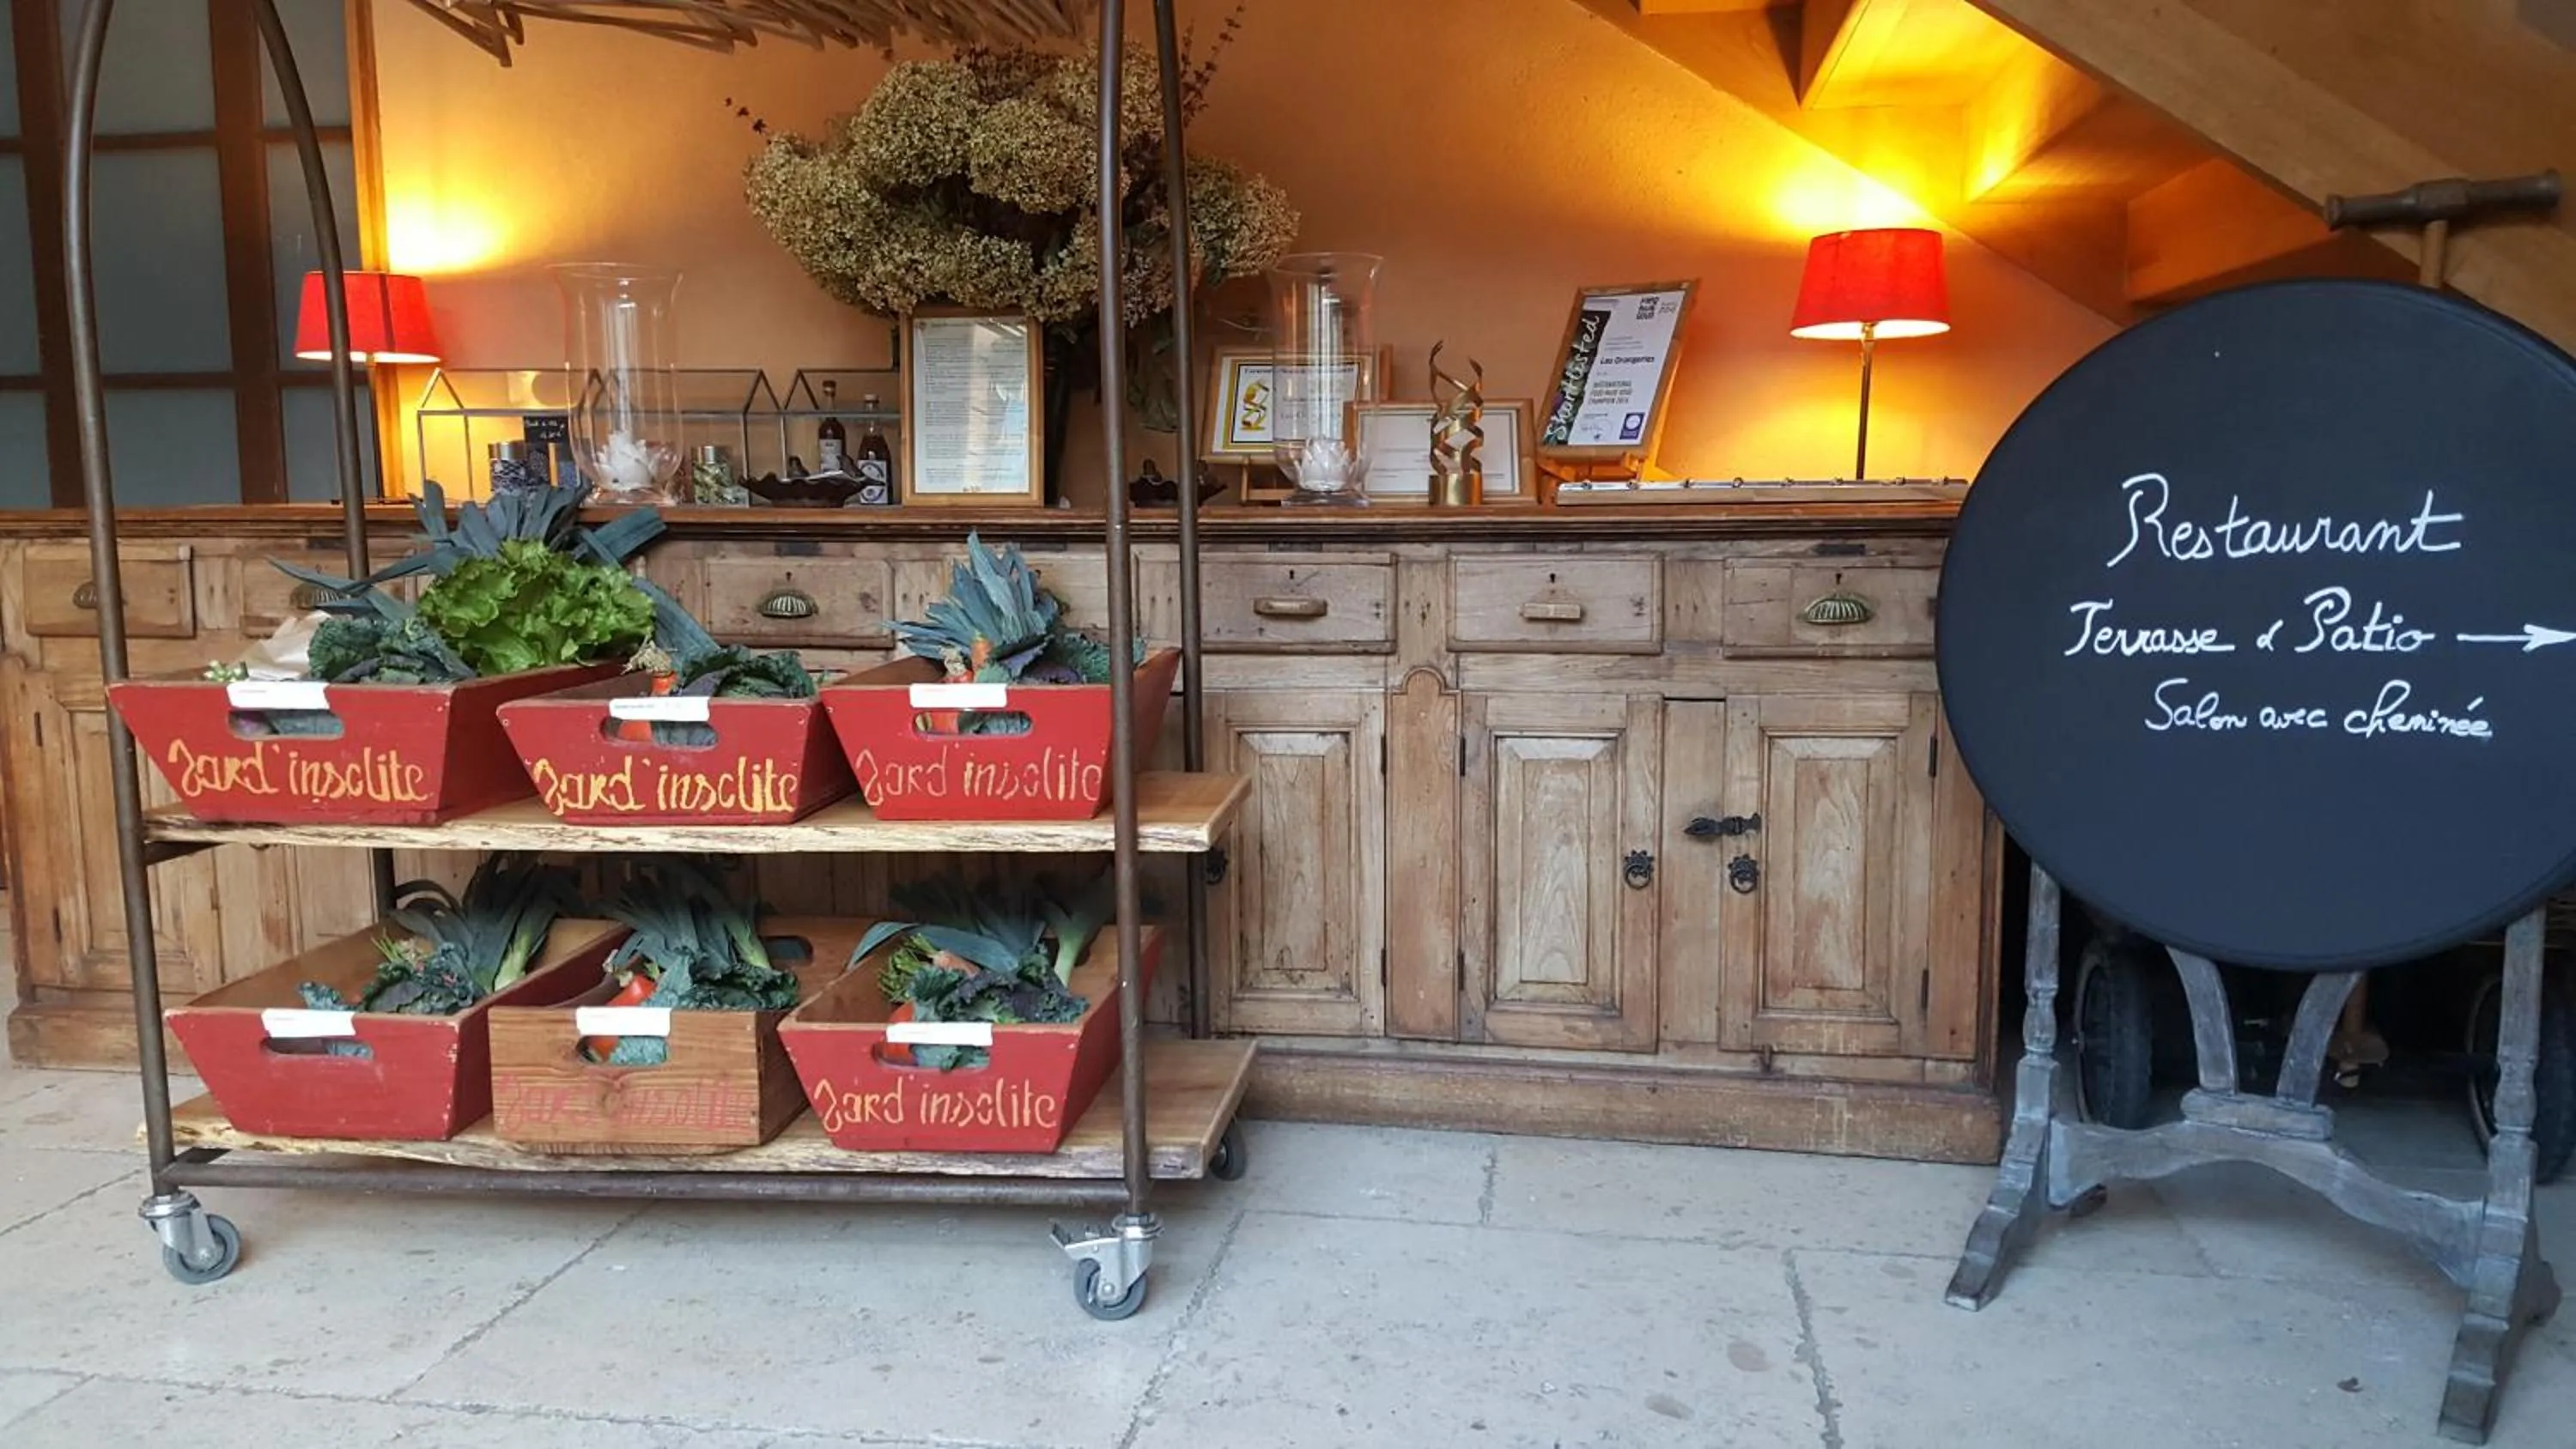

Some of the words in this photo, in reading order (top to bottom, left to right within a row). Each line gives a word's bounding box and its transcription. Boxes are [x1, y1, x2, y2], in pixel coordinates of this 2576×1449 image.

[2106, 472, 2464, 567] Restaurant
[2063, 599, 2235, 657] Terrasse
[2294, 586, 2435, 653] Patio
[2144, 677, 2247, 731] Salon
[2259, 706, 2328, 729] avec
